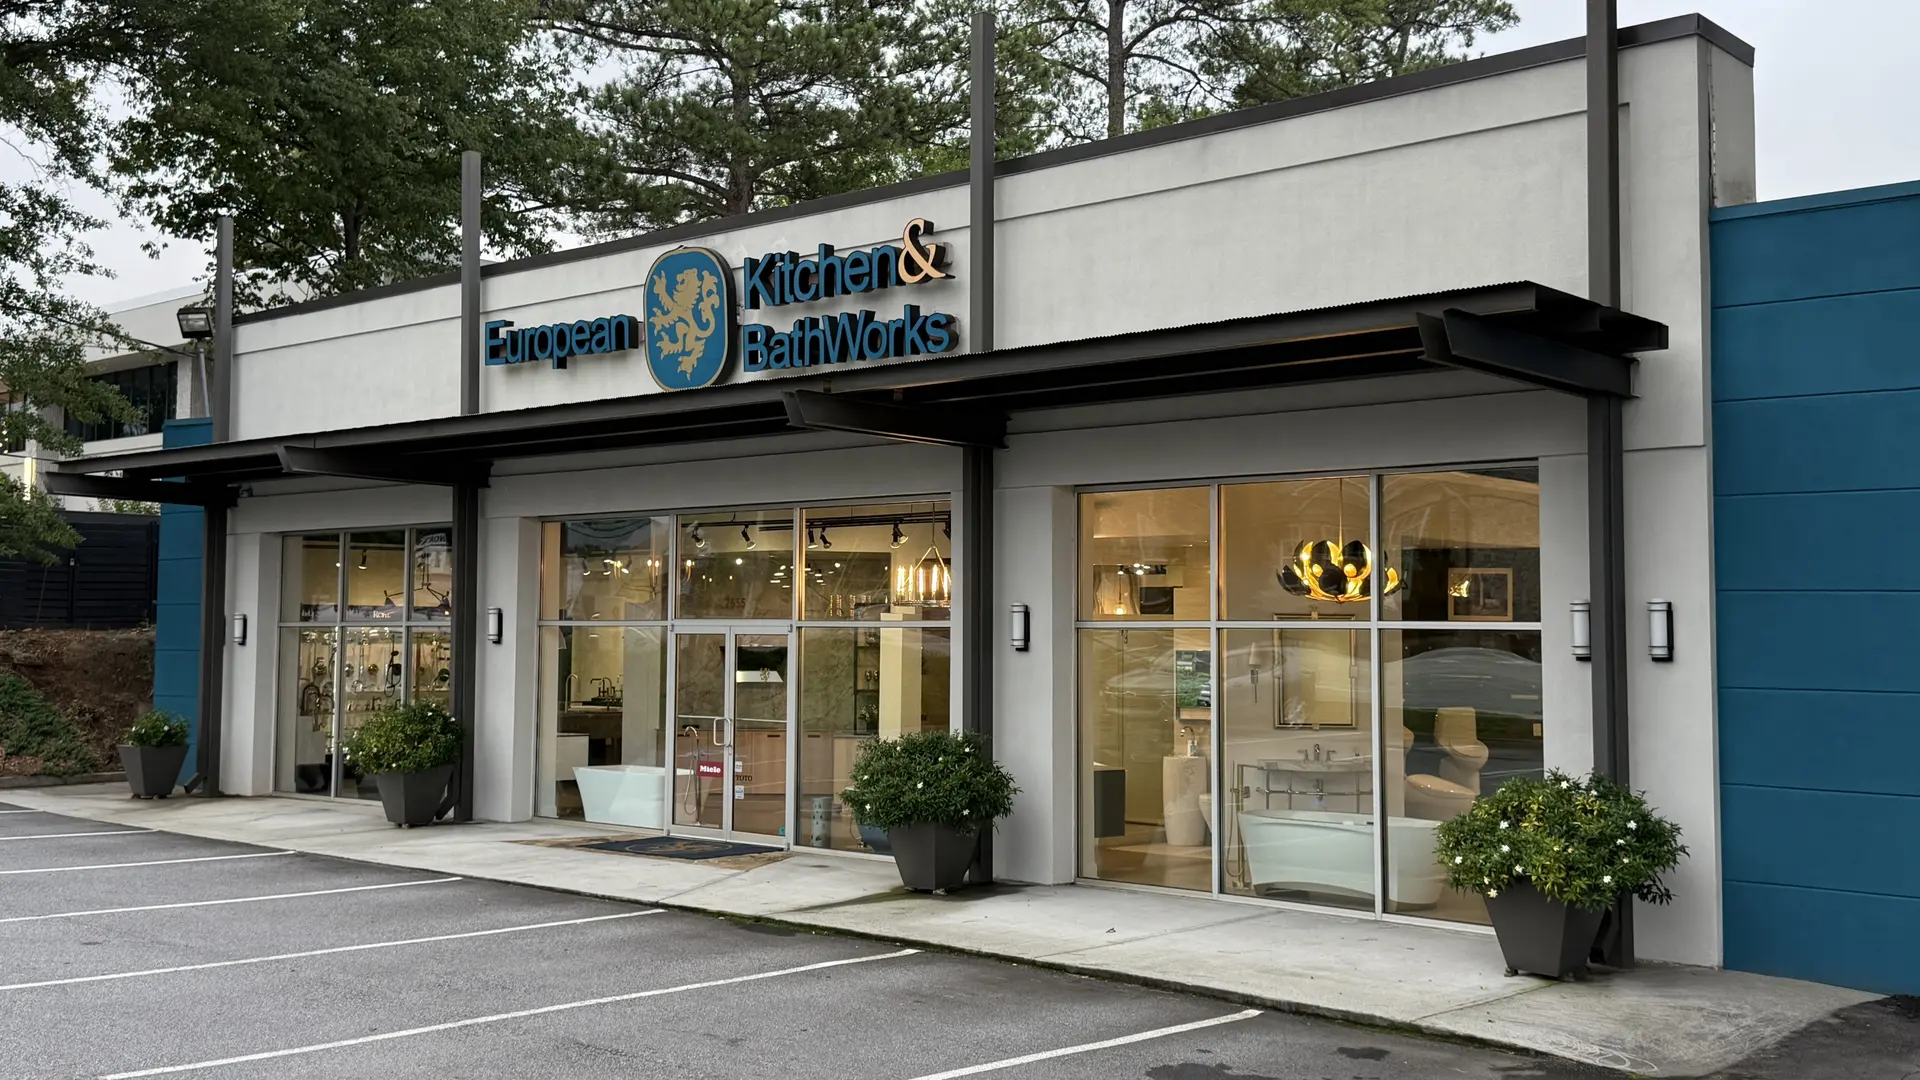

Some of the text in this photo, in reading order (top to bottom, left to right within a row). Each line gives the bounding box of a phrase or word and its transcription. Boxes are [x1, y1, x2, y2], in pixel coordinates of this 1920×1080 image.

[485, 313, 636, 369] European
[743, 304, 956, 372] BathWorks
[700, 765, 721, 774] Miele
